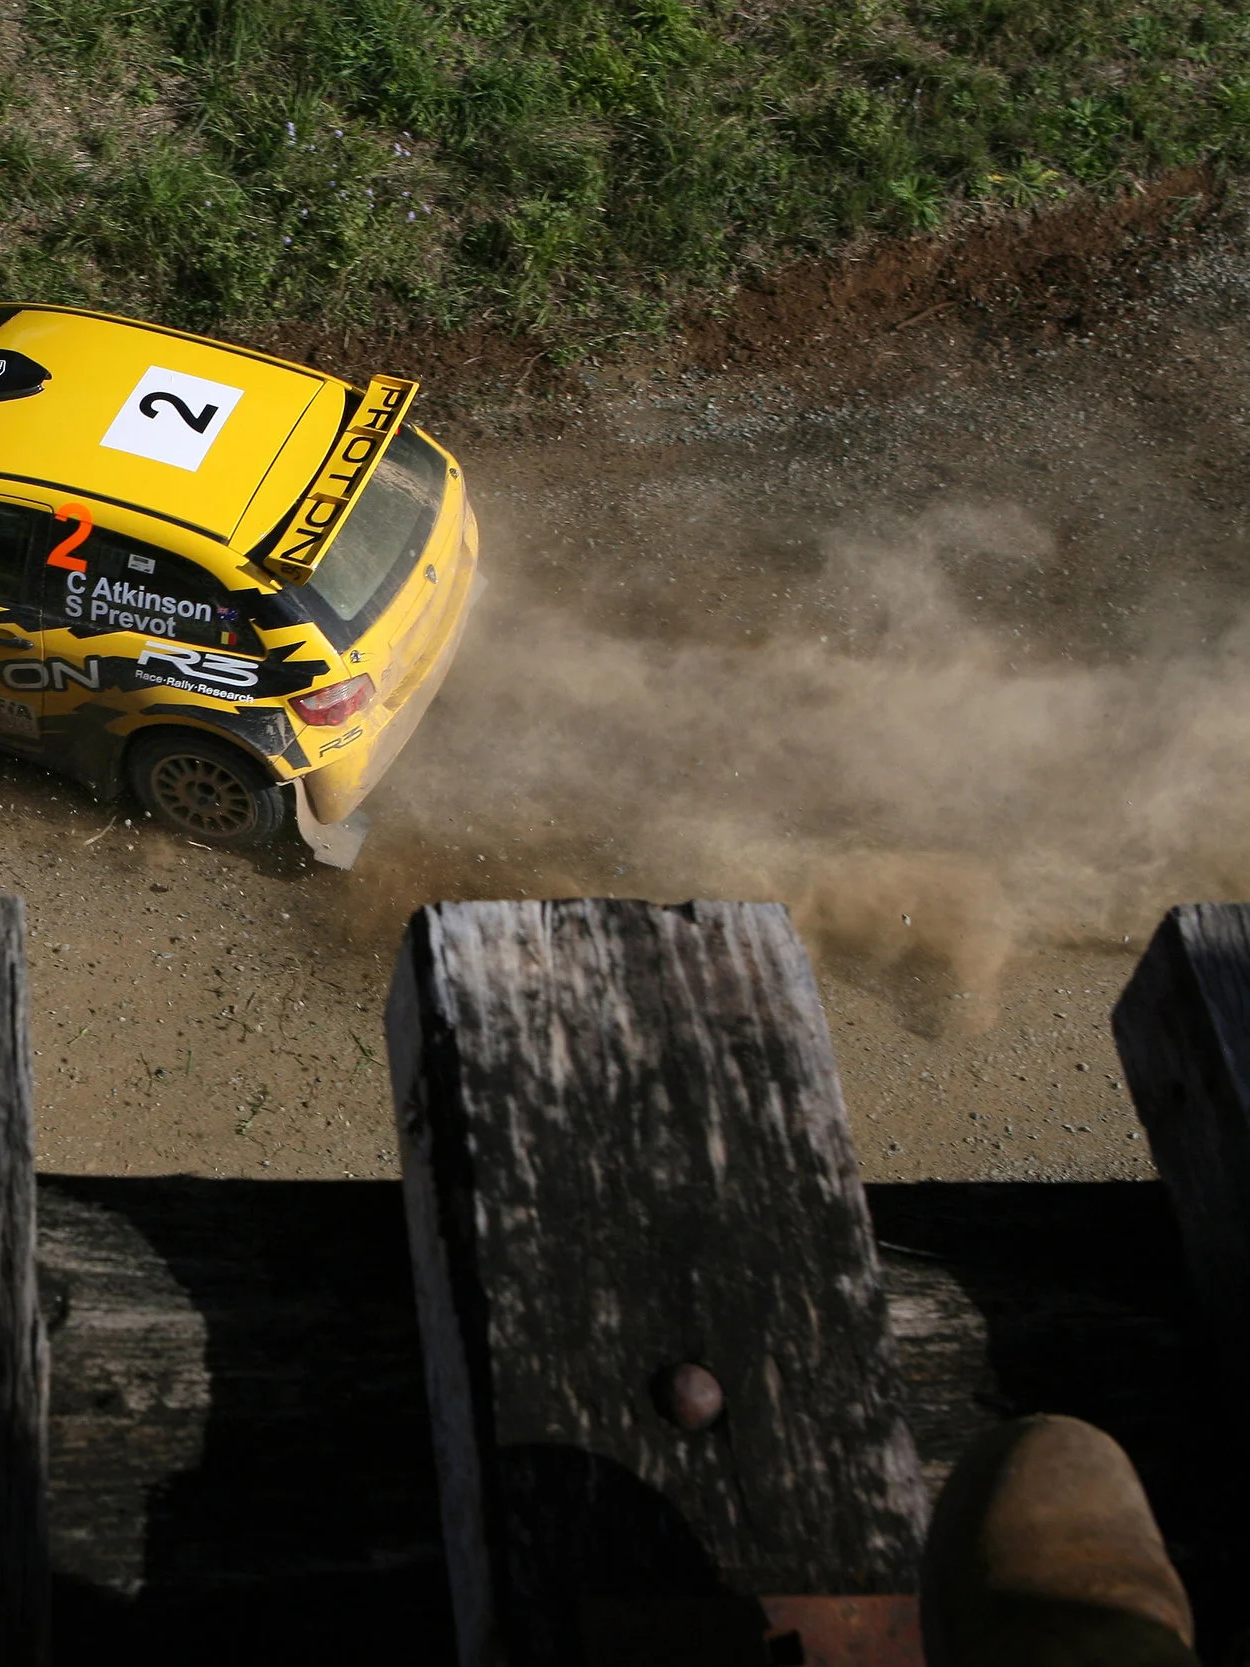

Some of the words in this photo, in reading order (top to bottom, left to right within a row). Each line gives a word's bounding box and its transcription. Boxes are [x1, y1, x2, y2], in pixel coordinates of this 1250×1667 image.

[139, 391, 219, 434] 2
[47, 503, 93, 573] 2
[65, 595, 83, 618] S
[91, 599, 176, 638] Prevot
[67, 571, 87, 596] C
[91, 577, 212, 623] Atkinson
[137, 641, 259, 687] R3
